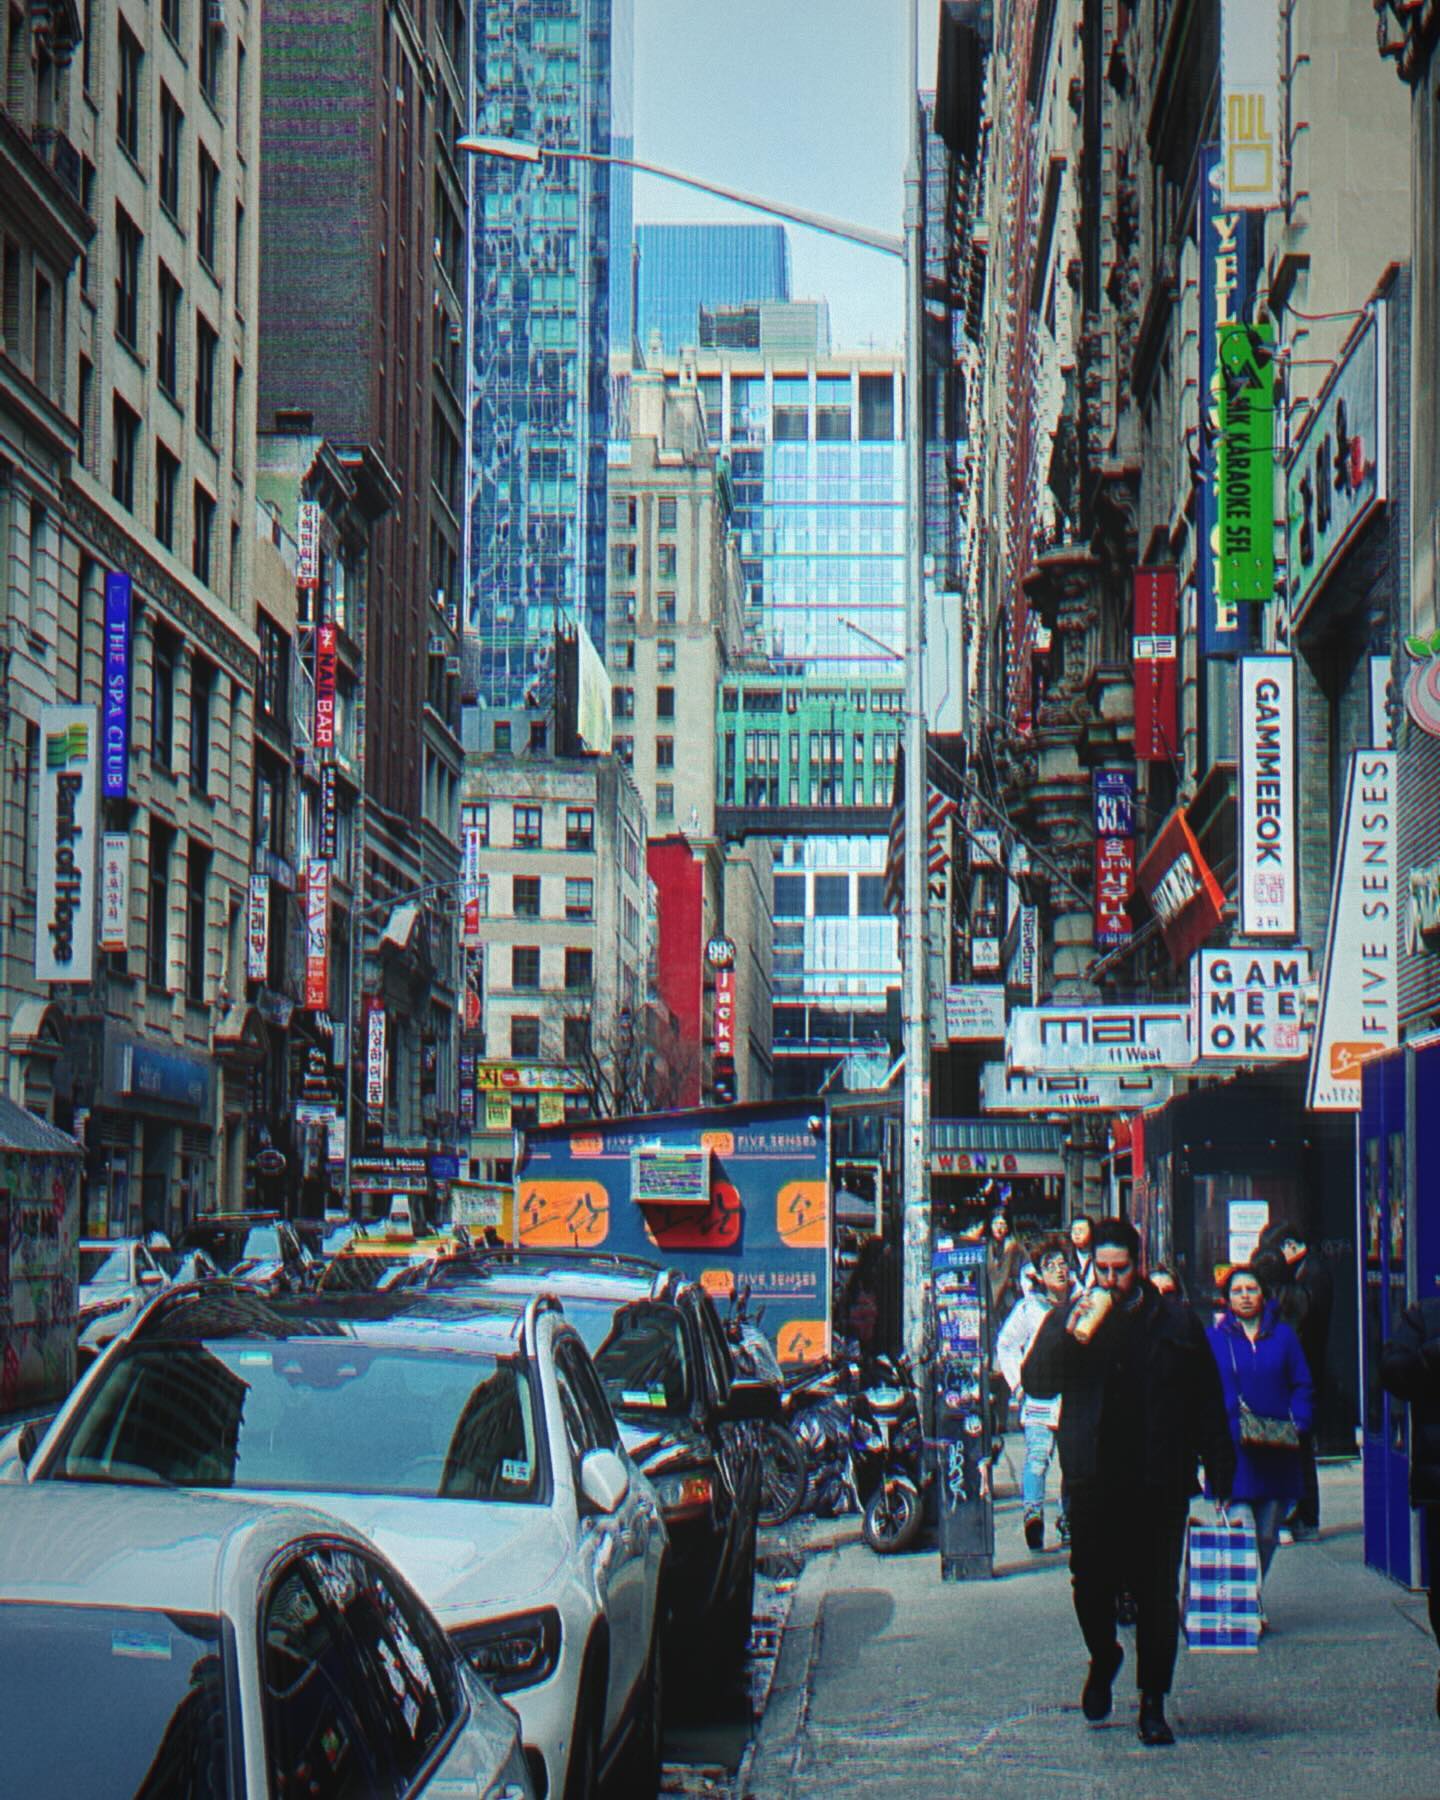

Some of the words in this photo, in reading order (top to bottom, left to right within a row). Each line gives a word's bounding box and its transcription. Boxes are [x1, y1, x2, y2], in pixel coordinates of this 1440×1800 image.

[1226, 433, 1251, 518] KARAOKE
[1226, 526, 1251, 556] 5FL
[110, 621, 126, 664] THE
[108, 674, 125, 717] SPA
[317, 652, 335, 699] NAIL
[316, 700, 333, 743] BAR
[107, 724, 125, 788] CLUB
[1255, 678, 1282, 866] GAMMEEOK
[56, 771, 82, 847] Bank
[1361, 760, 1389, 921] SENSES
[55, 848, 81, 877] of
[47, 881, 81, 966] Hope
[1210, 960, 1299, 987] GAM
[1362, 943, 1389, 1035] FIVE
[1210, 992, 1297, 1018] MEE
[1040, 1015, 1191, 1045] mar
[1211, 1024, 1266, 1051] OK
[1110, 1048, 1123, 1062] 11
[1126, 1048, 1162, 1063] West
[1059, 1095, 1070, 1106] 11
[1073, 1096, 1101, 1106] West
[737, 1135, 766, 1148] FIVE
[770, 1135, 817, 1148] SENSES
[737, 1273, 766, 1286] FIVE
[770, 1273, 817, 1286] SENSES
